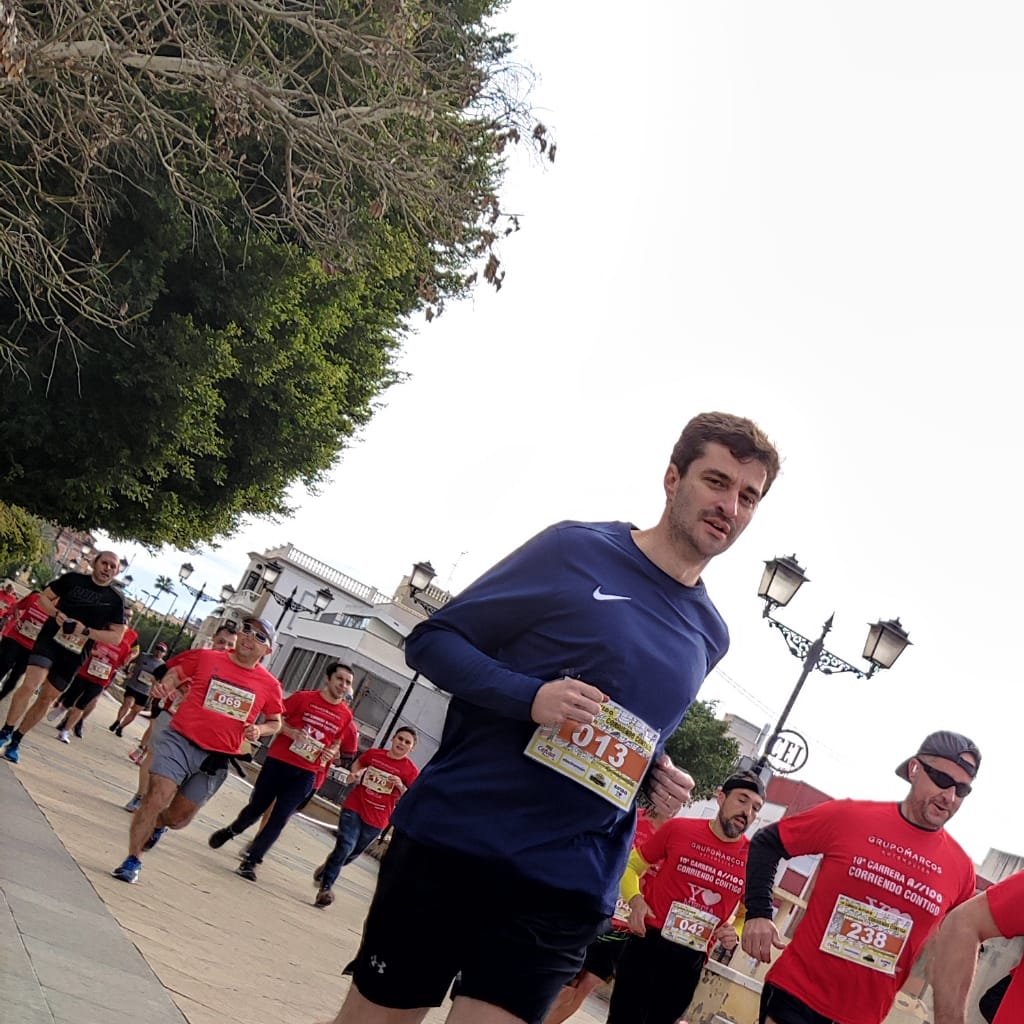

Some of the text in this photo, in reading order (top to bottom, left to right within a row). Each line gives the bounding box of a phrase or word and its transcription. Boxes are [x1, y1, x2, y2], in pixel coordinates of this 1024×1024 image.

[218, 694, 241, 708] 069
[571, 724, 628, 768] 013
[676, 864, 742, 893] CORRIENDO CONTIGO
[867, 860, 905, 883] CARRERA
[848, 866, 902, 895] CORRIENDO
[903, 889, 941, 916] CONTIGO
[679, 919, 705, 937] 042
[847, 922, 887, 948] 238
